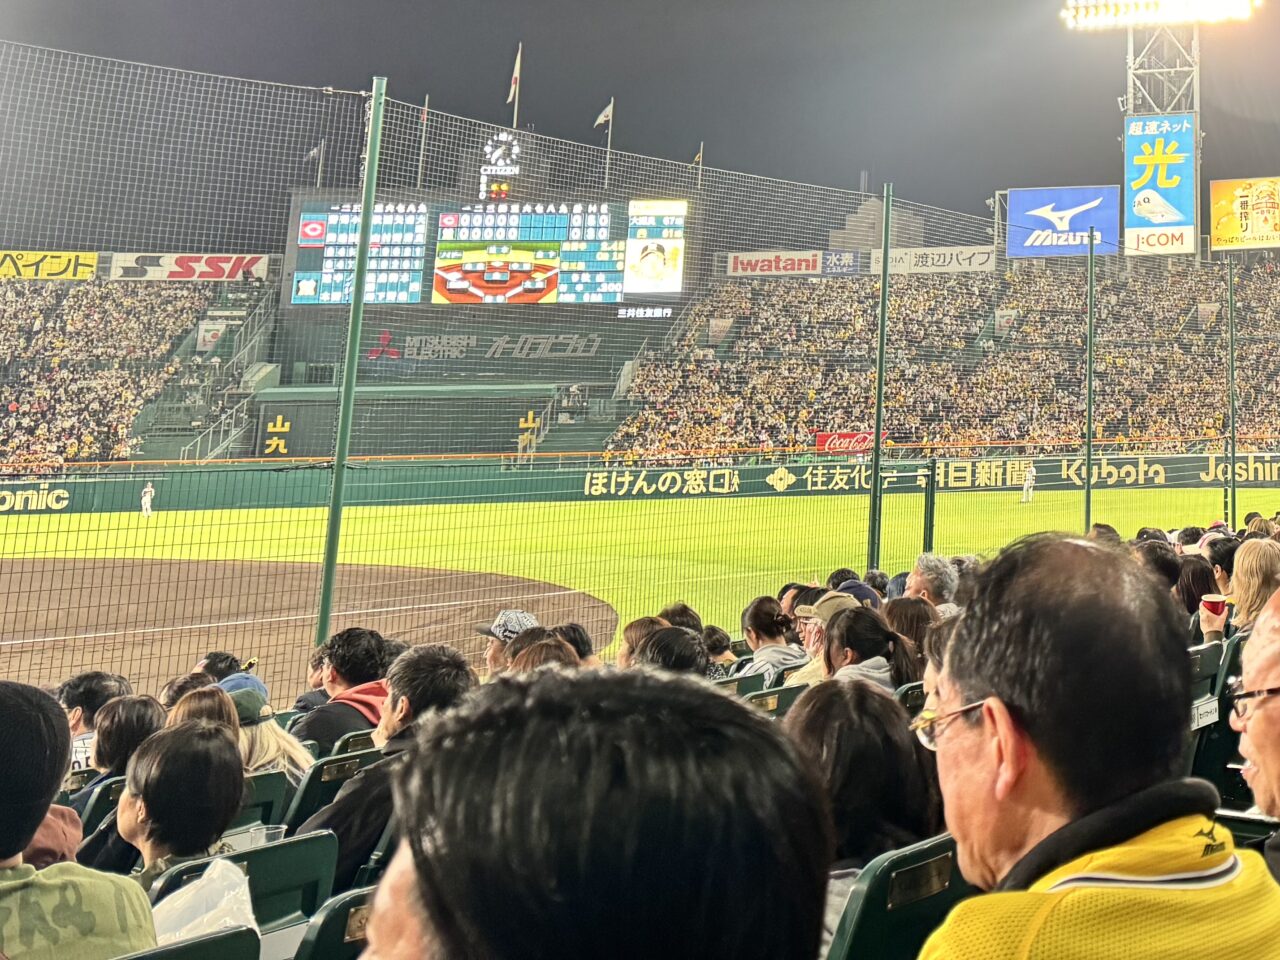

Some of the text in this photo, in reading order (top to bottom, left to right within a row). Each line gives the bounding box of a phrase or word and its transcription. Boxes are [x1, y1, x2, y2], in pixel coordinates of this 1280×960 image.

[1128, 120, 1191, 136] 超速ネット
[480, 166, 519, 175] CITIZEN
[1130, 138, 1190, 191] 光
[1239, 194, 1249, 233] 一番搾り
[1135, 232, 1184, 251] J:COM
[0, 253, 94, 277] ペイント
[167, 256, 263, 279] SSK
[732, 254, 818, 273] Iwatani
[827, 252, 854, 266] 水素
[913, 249, 995, 268] 渡辺パイプ
[405, 336, 476, 347] MITSUBISHI
[404, 347, 466, 359] ELECTRIC
[264, 415, 291, 453] 山九
[584, 469, 730, 495] ほけんの窓口
[1061, 458, 1165, 486] Kubota
[0, 483, 69, 511] onic
